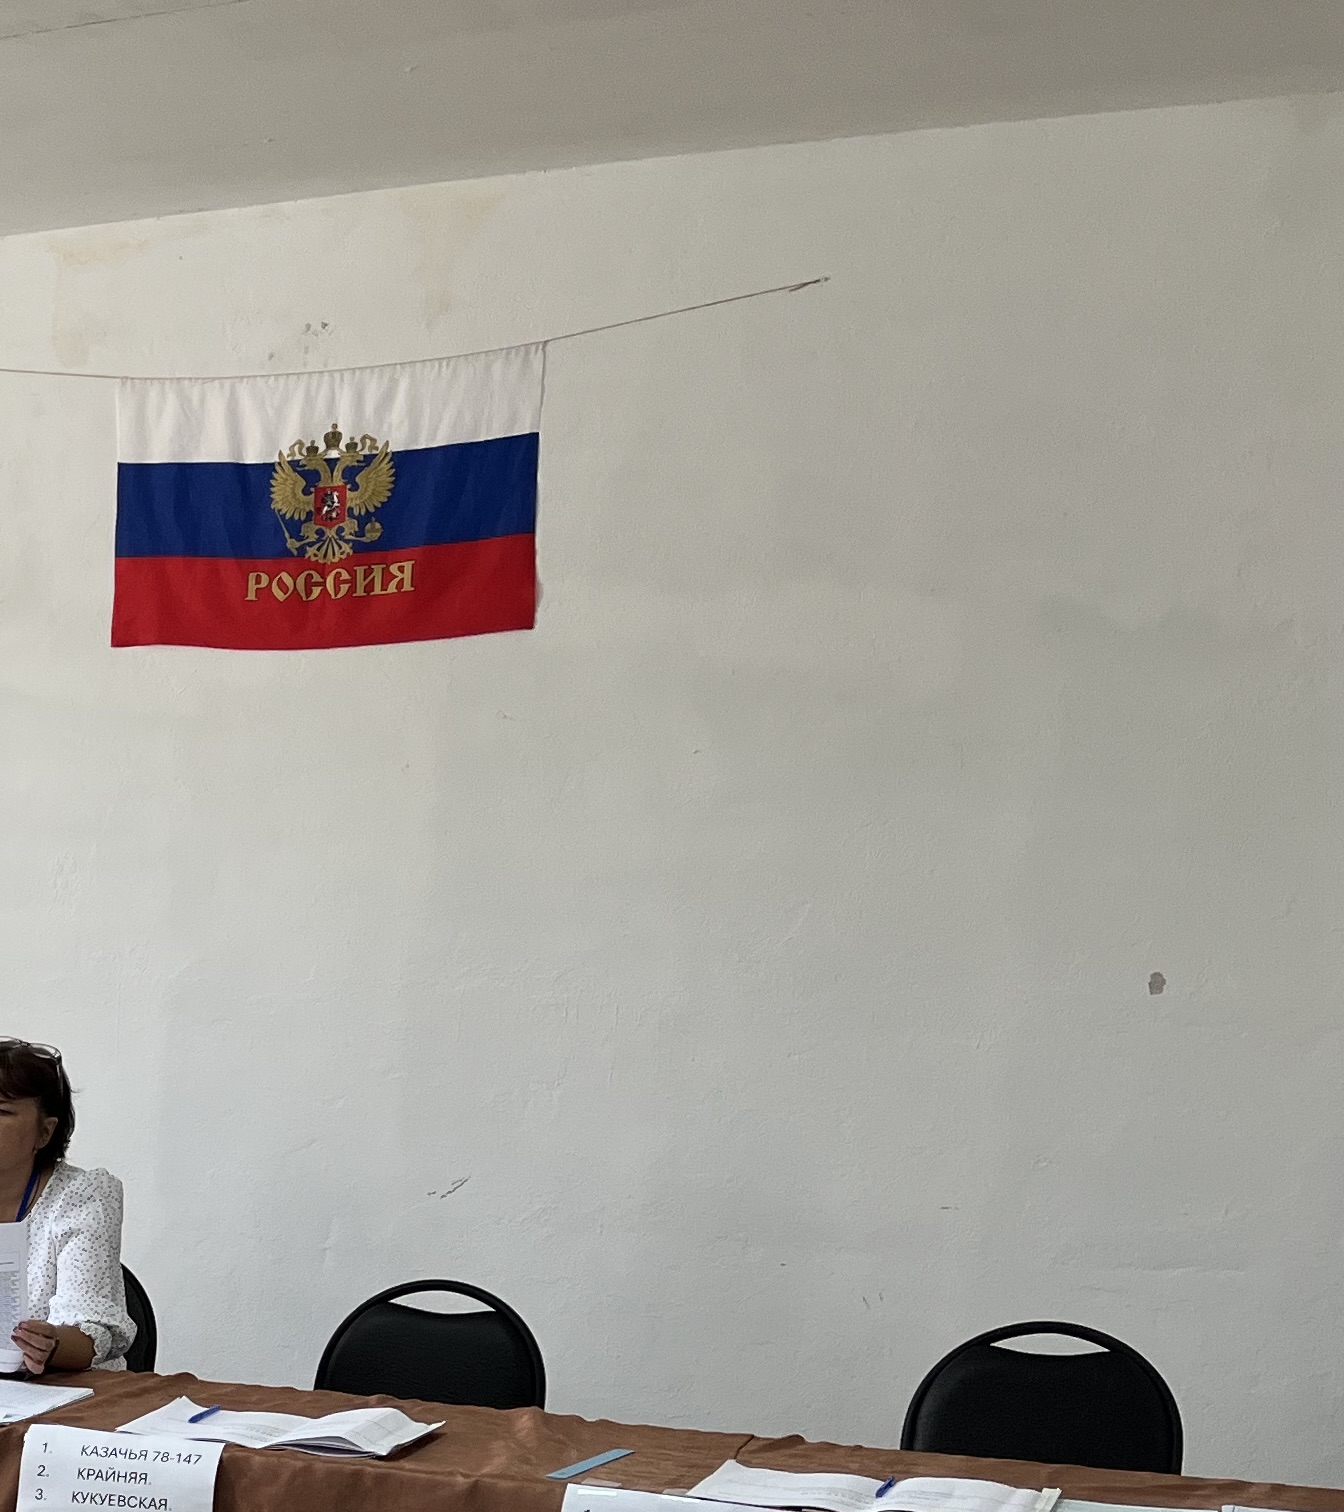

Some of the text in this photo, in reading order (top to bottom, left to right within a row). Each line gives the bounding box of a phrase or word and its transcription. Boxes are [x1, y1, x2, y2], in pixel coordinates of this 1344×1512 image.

[244, 560, 416, 602] РОССИЯ
[42, 1442, 202, 1465] 1. КАЗАЧЬЯ 78-147
[36, 1464, 152, 1486] 2. КРАЙНЯЯ.
[34, 1488, 173, 1512] 3. КУКУЕВСКАЯ.
